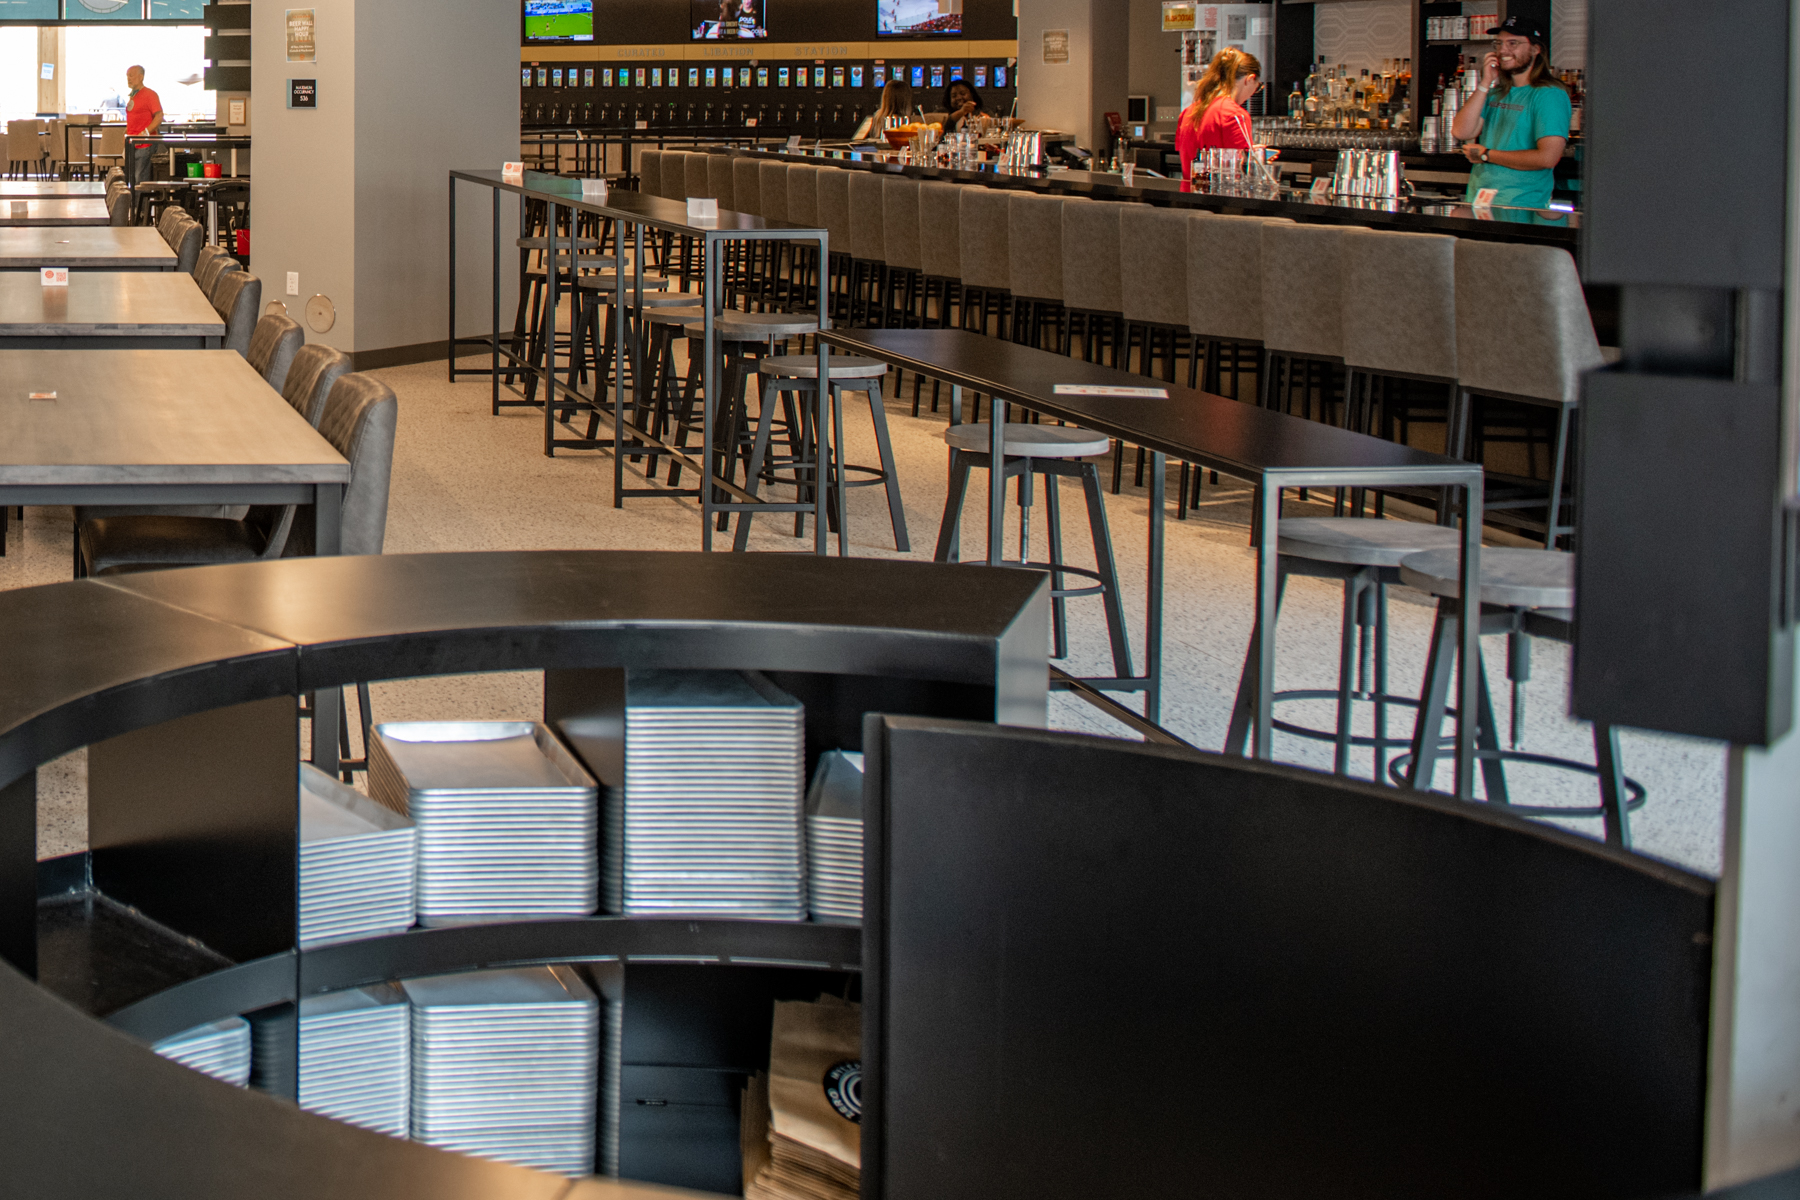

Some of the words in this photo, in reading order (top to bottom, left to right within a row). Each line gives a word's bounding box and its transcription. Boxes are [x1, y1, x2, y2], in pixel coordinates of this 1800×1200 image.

[617, 47, 665, 58] CURATED
[703, 46, 754, 57] LIBATION
[794, 45, 848, 57] STATION
[827, 1087, 856, 1119] ZERO
